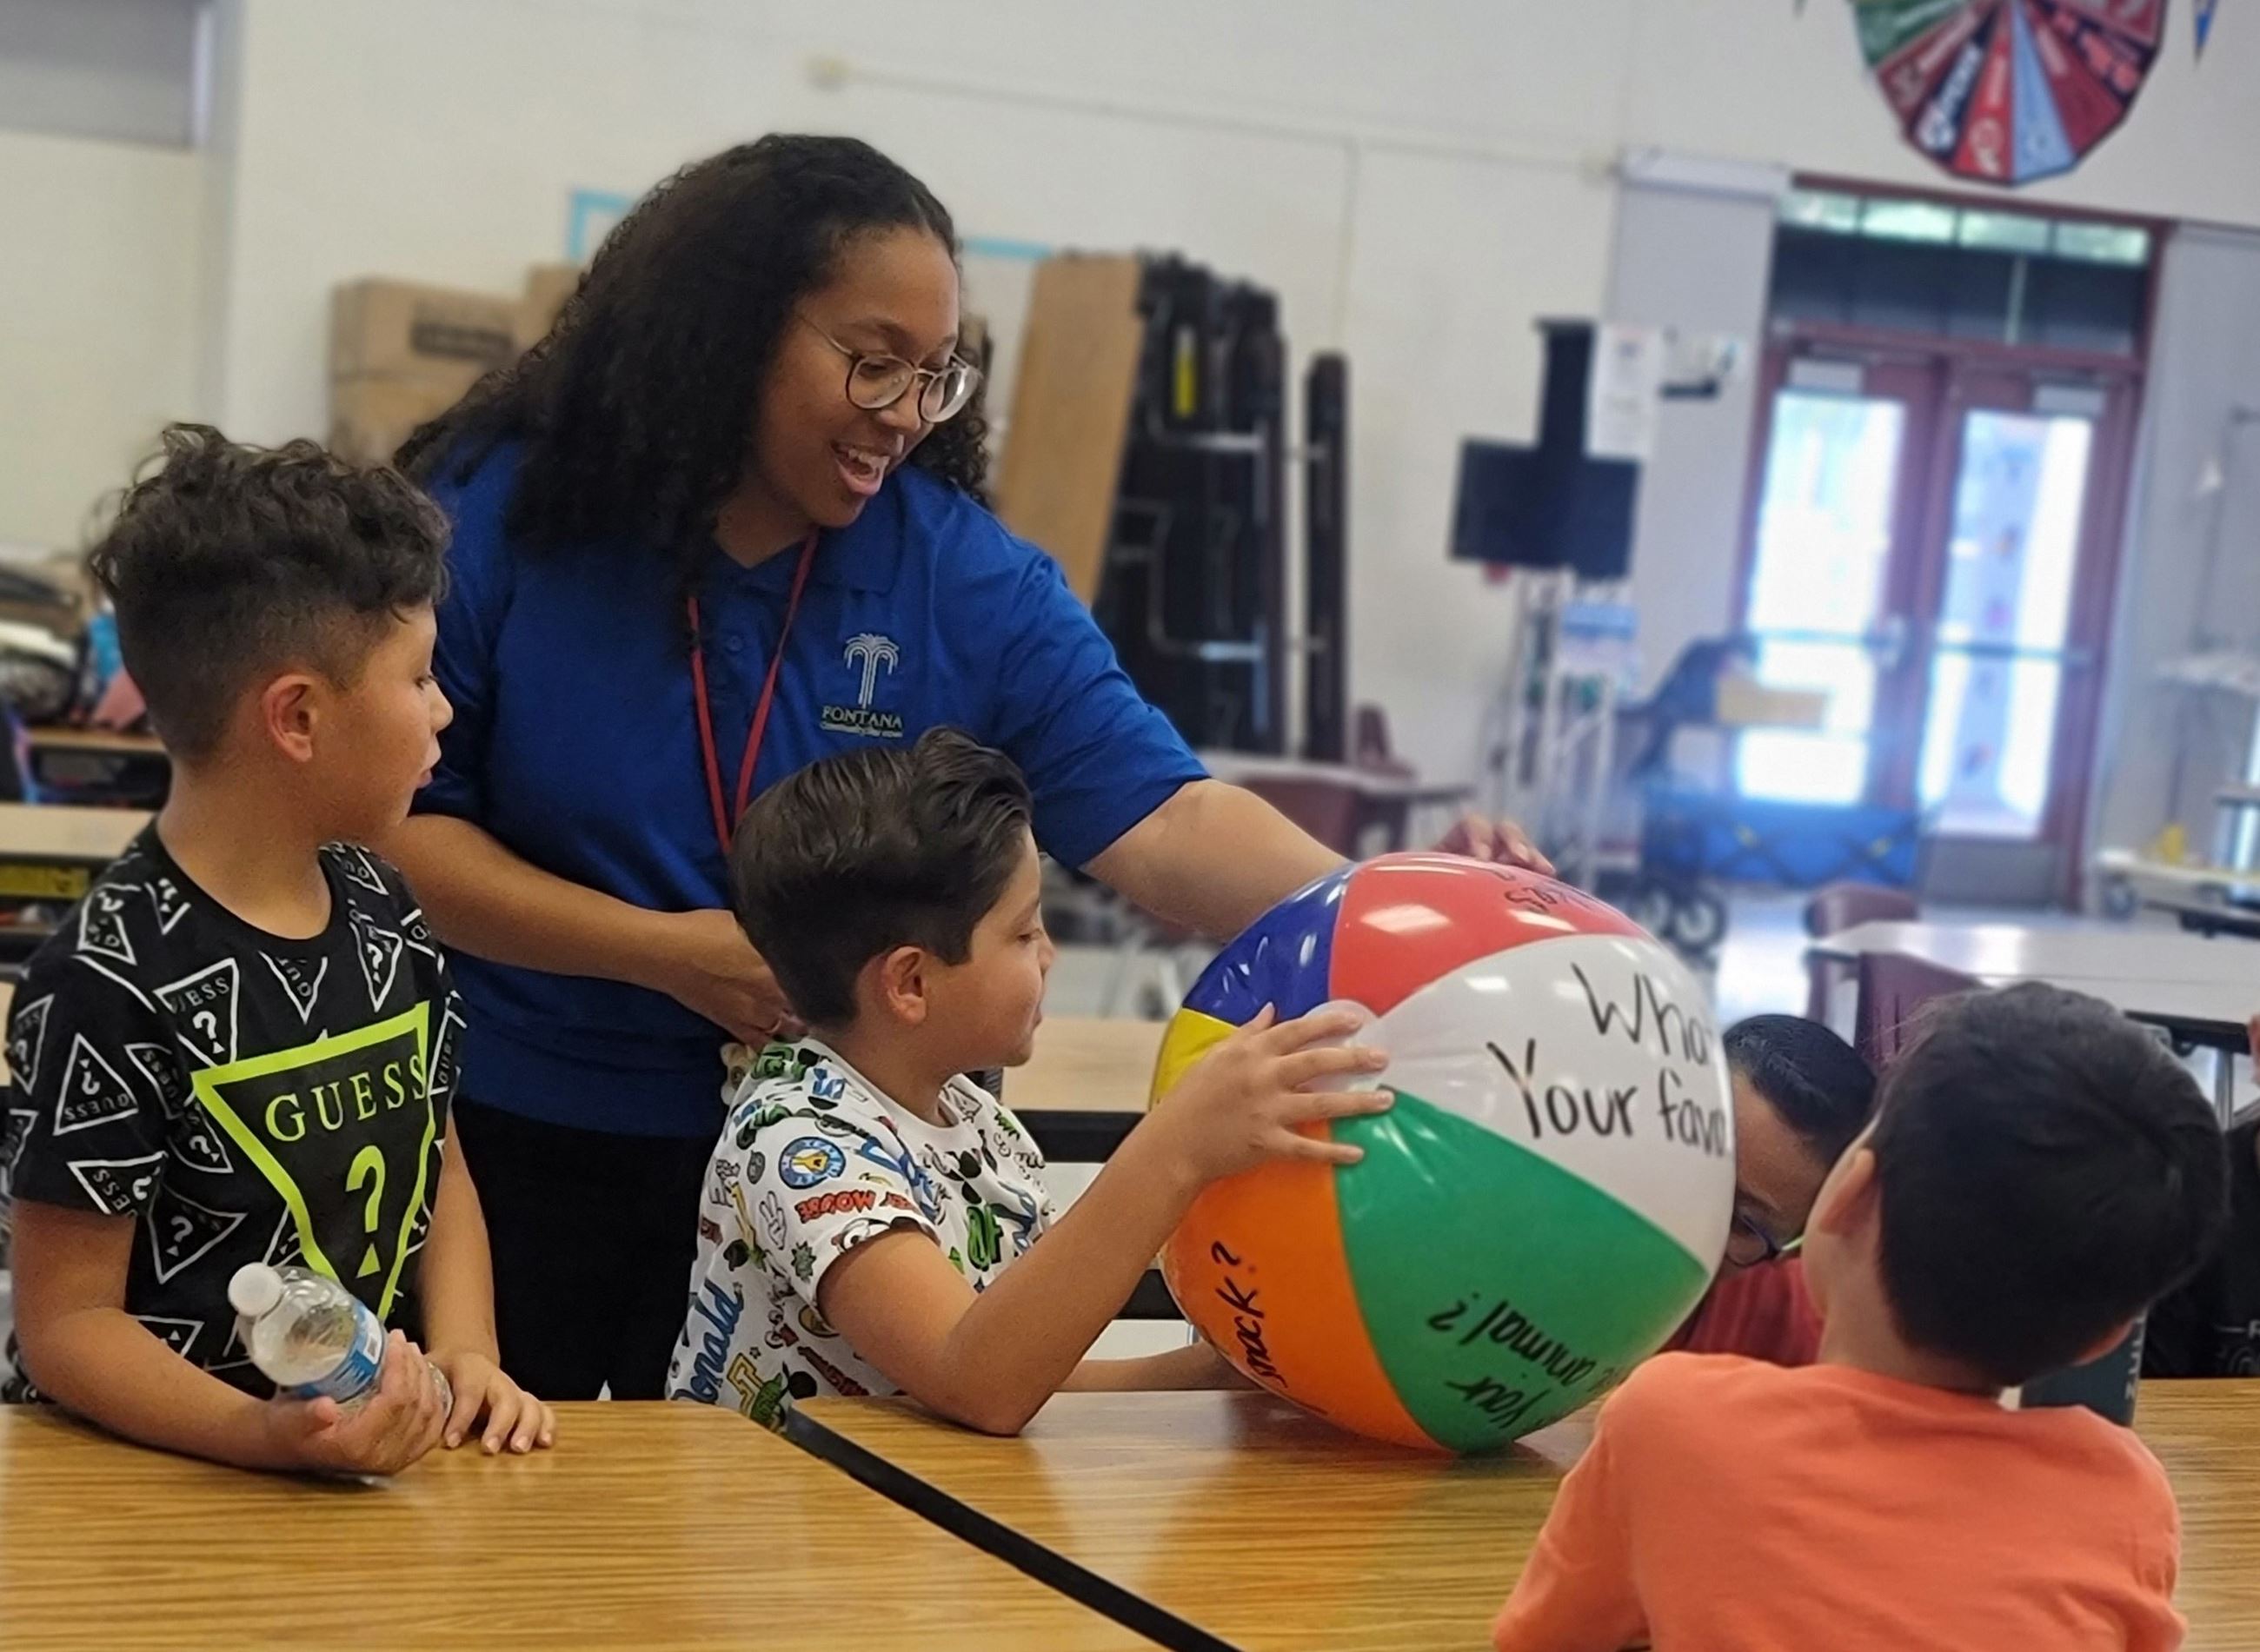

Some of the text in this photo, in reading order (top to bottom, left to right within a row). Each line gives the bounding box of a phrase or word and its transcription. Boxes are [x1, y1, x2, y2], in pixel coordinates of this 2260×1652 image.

[821, 705, 903, 729] FONTANA
[172, 977, 229, 1012] ESS
[1571, 962, 1709, 1065] Wha
[63, 1092, 130, 1121] GUESS
[264, 1054, 427, 1142] GUESS
[1486, 1038, 1638, 1138] Your
[92, 1169, 139, 1217] ESS
